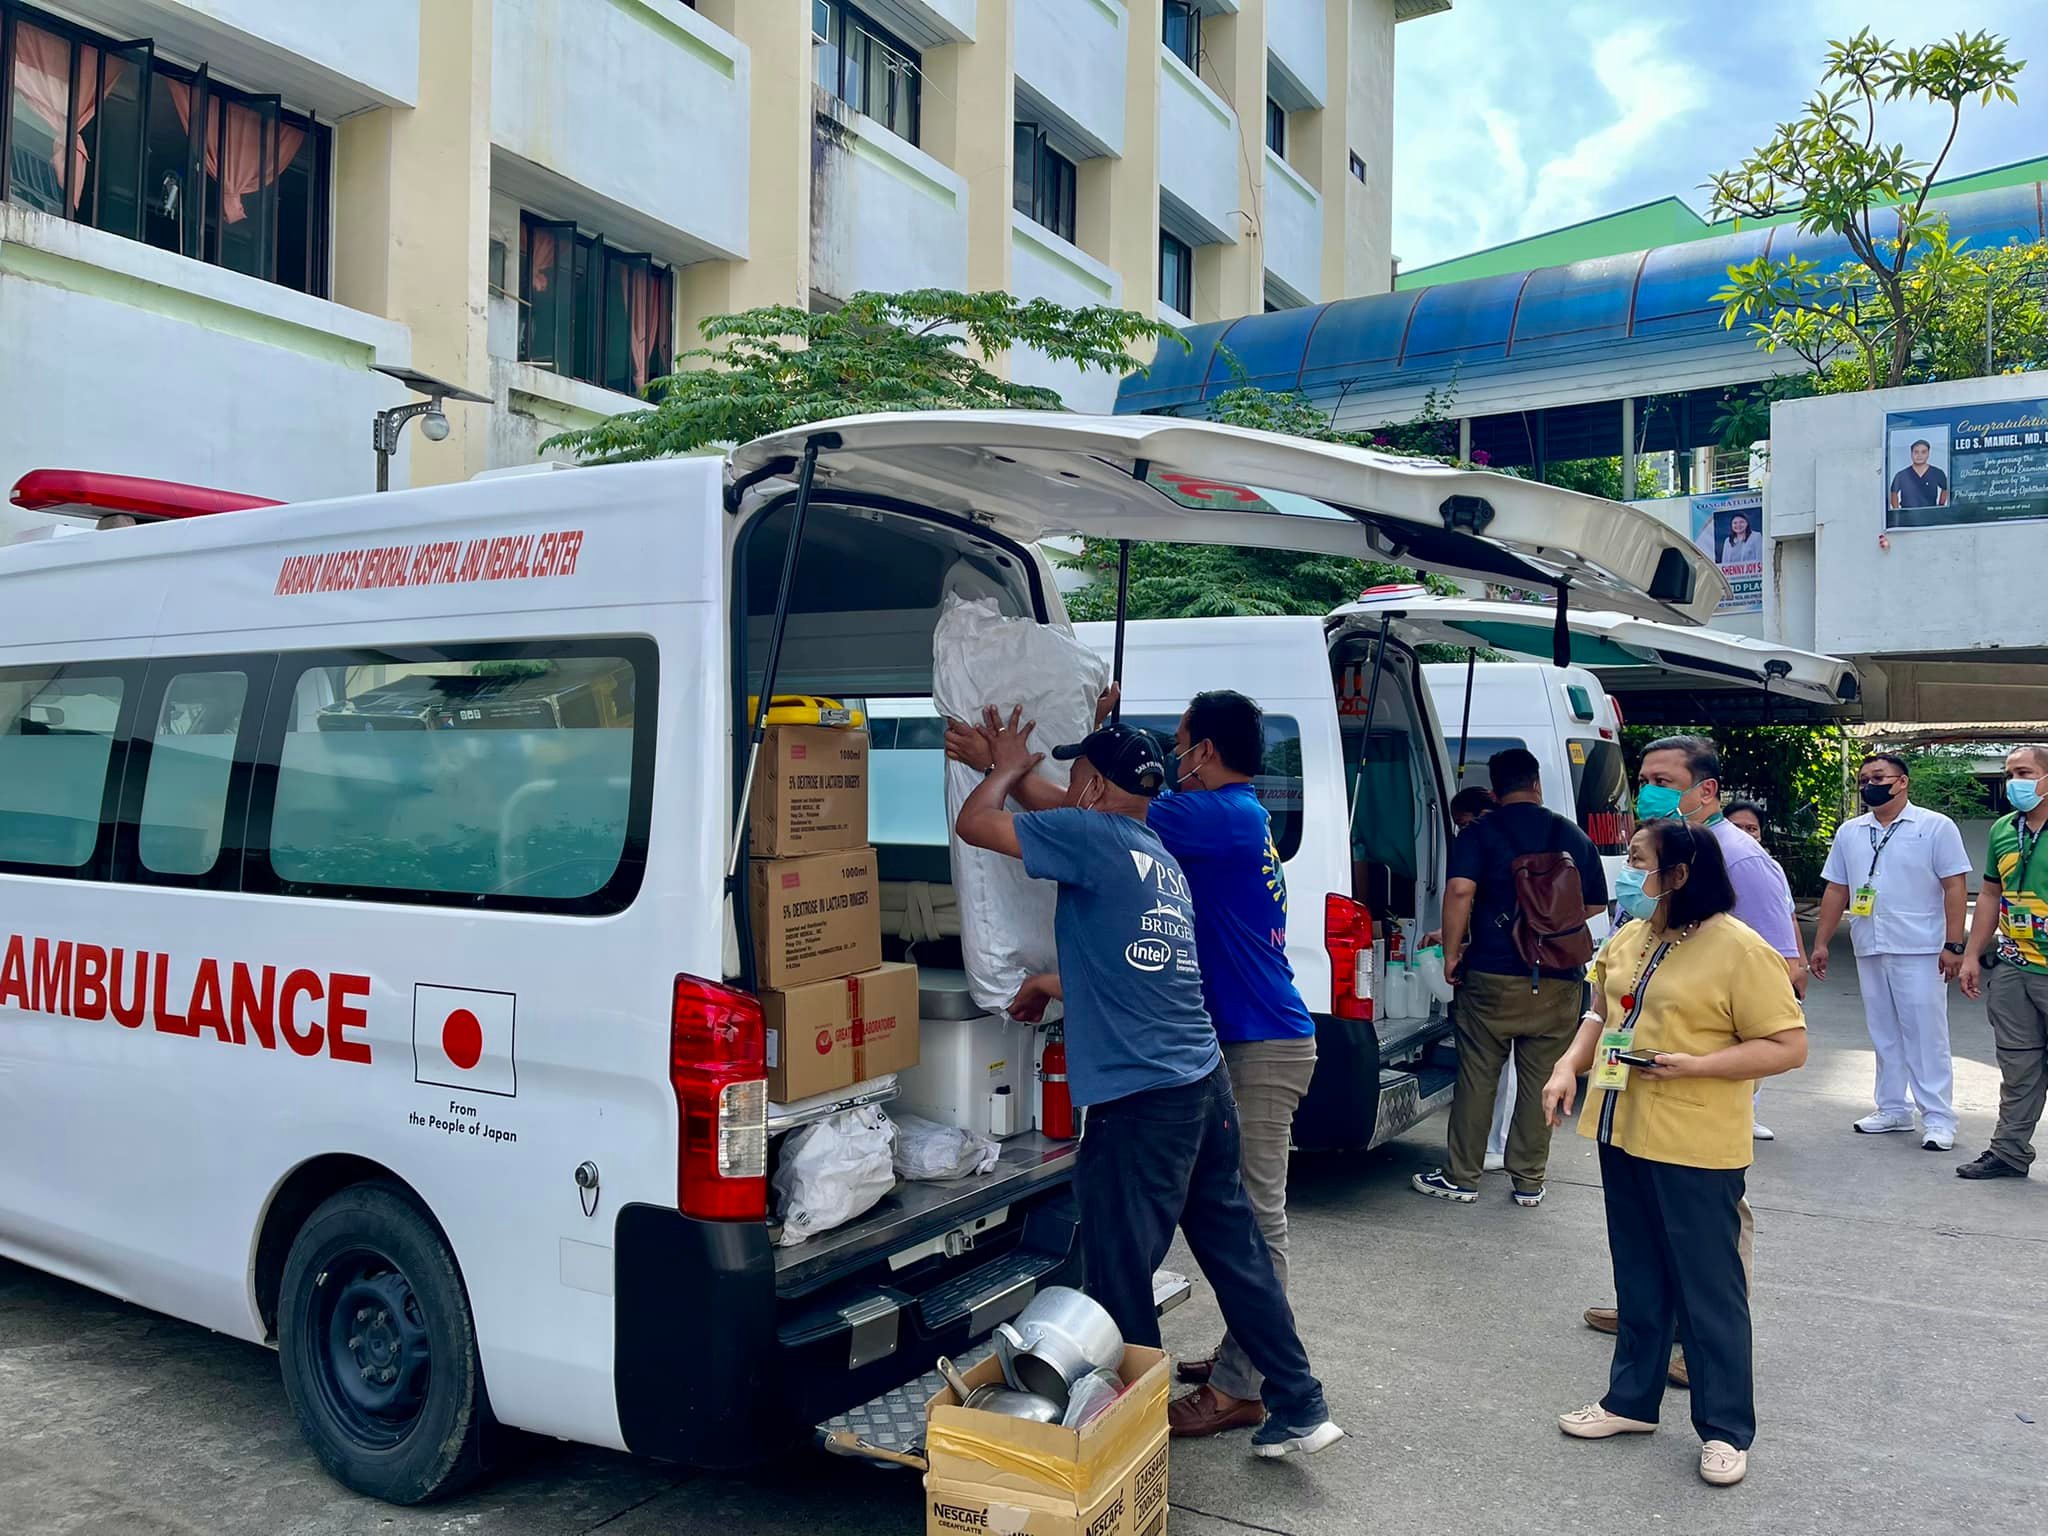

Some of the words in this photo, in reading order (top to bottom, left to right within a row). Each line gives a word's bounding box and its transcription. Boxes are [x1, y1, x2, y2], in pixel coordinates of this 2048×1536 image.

[1955, 438, 1971, 450] LEO
[1973, 437, 1982, 449] S.
[2025, 431, 2043, 445] MD,
[274, 553, 325, 596] MARIANO
[317, 549, 365, 592] MARCOS
[356, 545, 413, 590] MEMORIAL
[408, 541, 463, 586] HOSPITAL
[456, 538, 488, 583] AND
[481, 534, 535, 581] MEDICAL
[531, 530, 584, 578] CENTER
[840, 749, 861, 761] 1000ml
[789, 775, 796, 790] 5%
[797, 775, 819, 789] DEXTROSE
[825, 775, 844, 788] LACTATED
[841, 864, 868, 879] 1000ml
[783, 904, 792, 919] 5%
[793, 899, 818, 917] DEXTROSE
[819, 898, 825, 912] IN
[826, 894, 849, 911] LACTATED
[1133, 941, 1165, 964] intel
[0, 934, 373, 1065] AMBULANCE
[449, 1101, 477, 1117] From
[409, 1111, 425, 1126] the
[428, 1115, 465, 1135] People
[468, 1122, 480, 1136] of
[483, 1124, 517, 1143] Japan
[934, 1502, 988, 1528] NESCAFÉ
